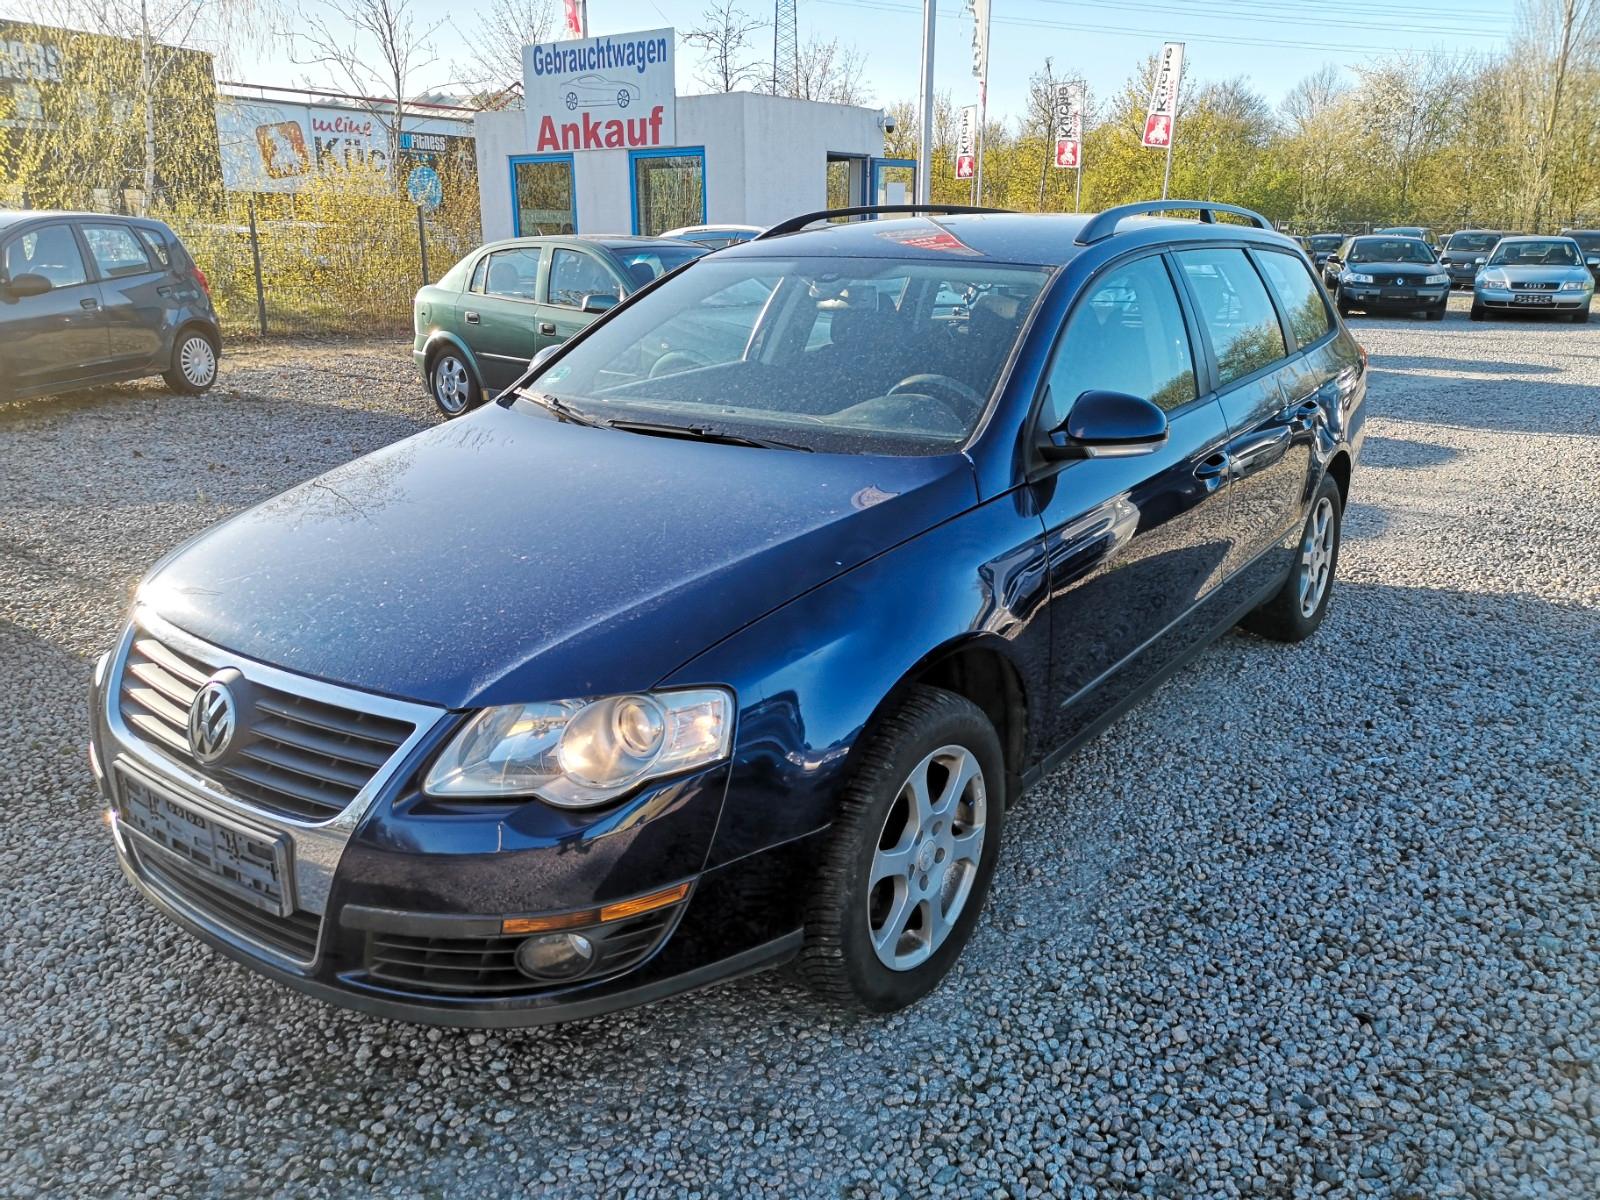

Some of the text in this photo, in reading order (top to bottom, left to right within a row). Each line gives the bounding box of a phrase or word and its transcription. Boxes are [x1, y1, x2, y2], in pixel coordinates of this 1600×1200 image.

[533, 37, 667, 76] Gebrauchtwagen
[312, 116, 372, 137] meine
[536, 105, 664, 151] Ankauf
